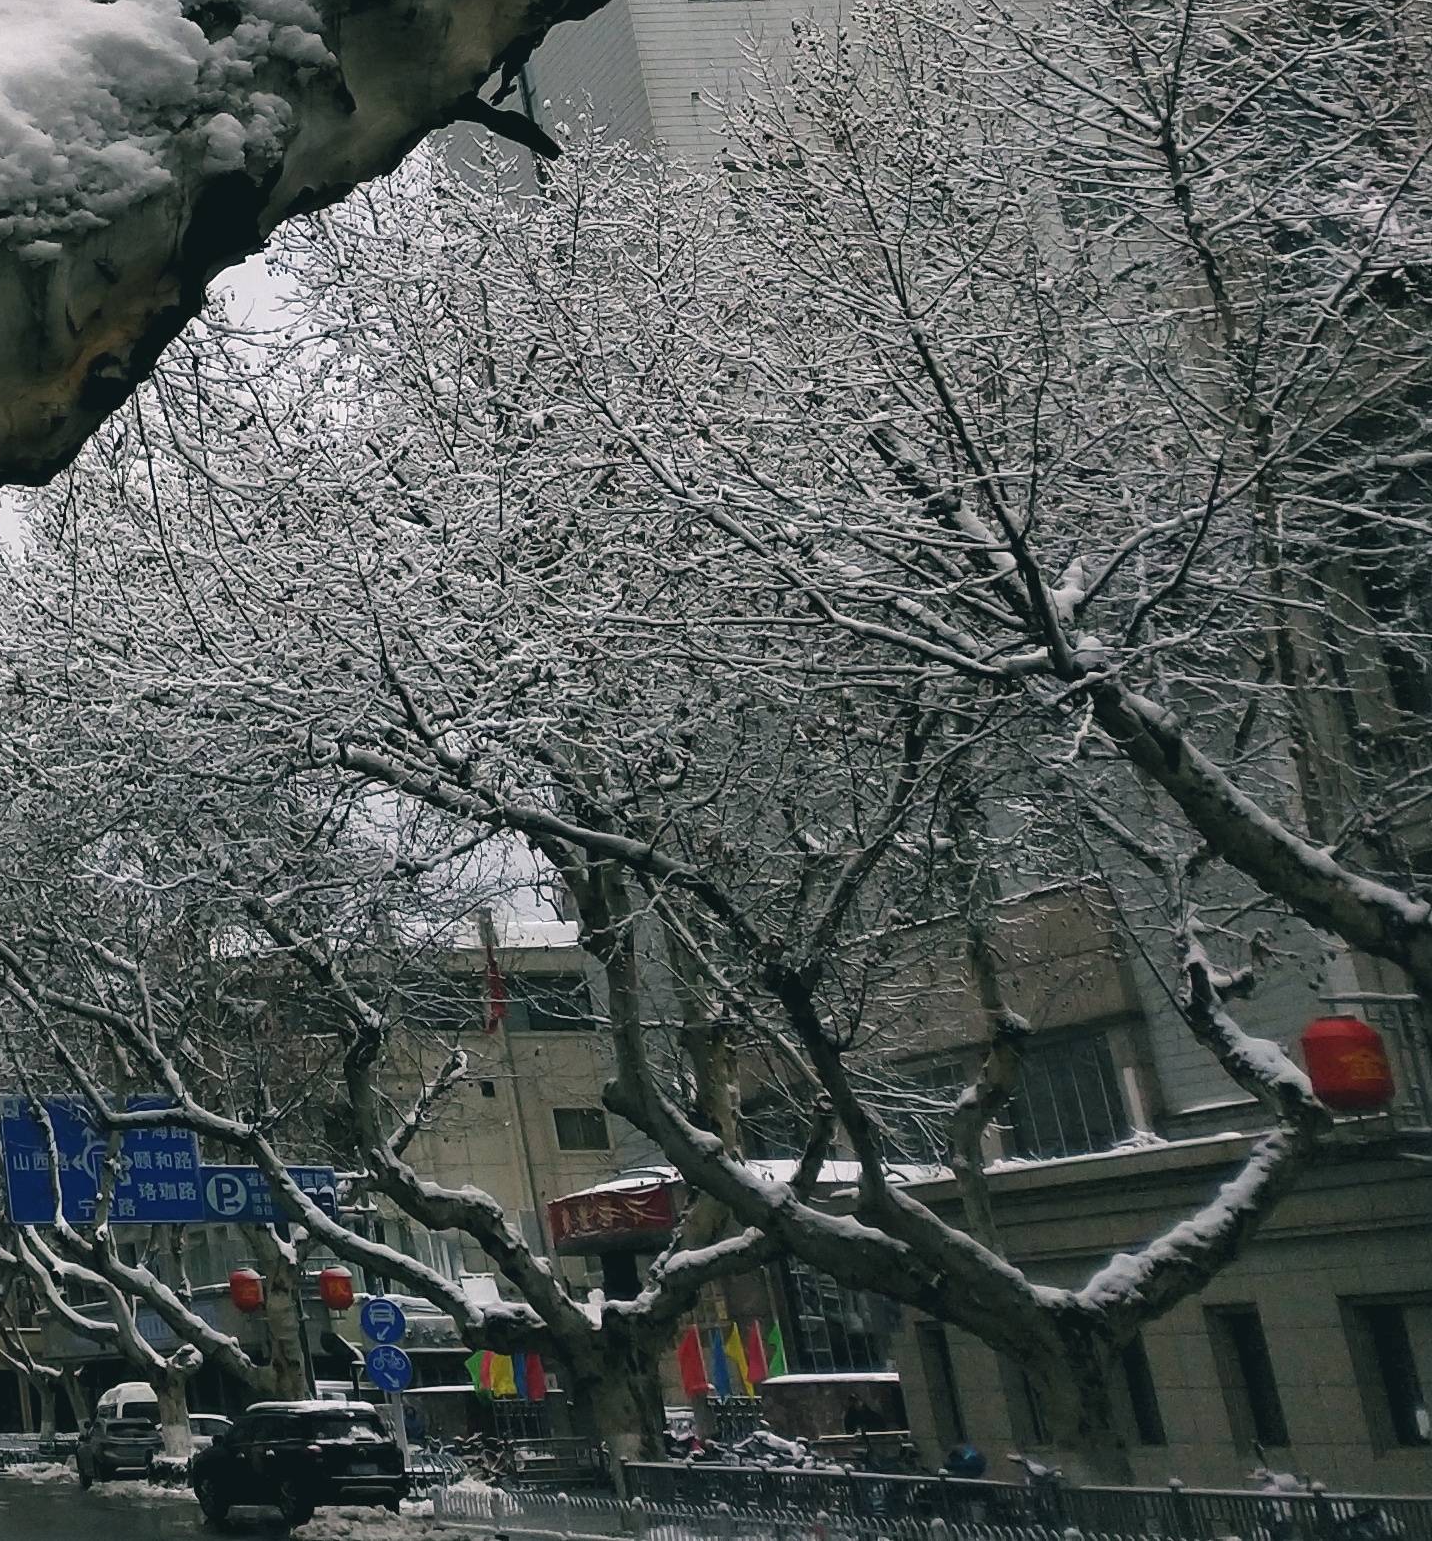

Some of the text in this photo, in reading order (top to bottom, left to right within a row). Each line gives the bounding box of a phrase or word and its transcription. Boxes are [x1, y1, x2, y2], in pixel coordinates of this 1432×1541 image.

[12, 1152, 70, 1172] 山西路
[133, 1151, 193, 1171] 颐和路
[138, 1182, 198, 1202] 珞珈路
